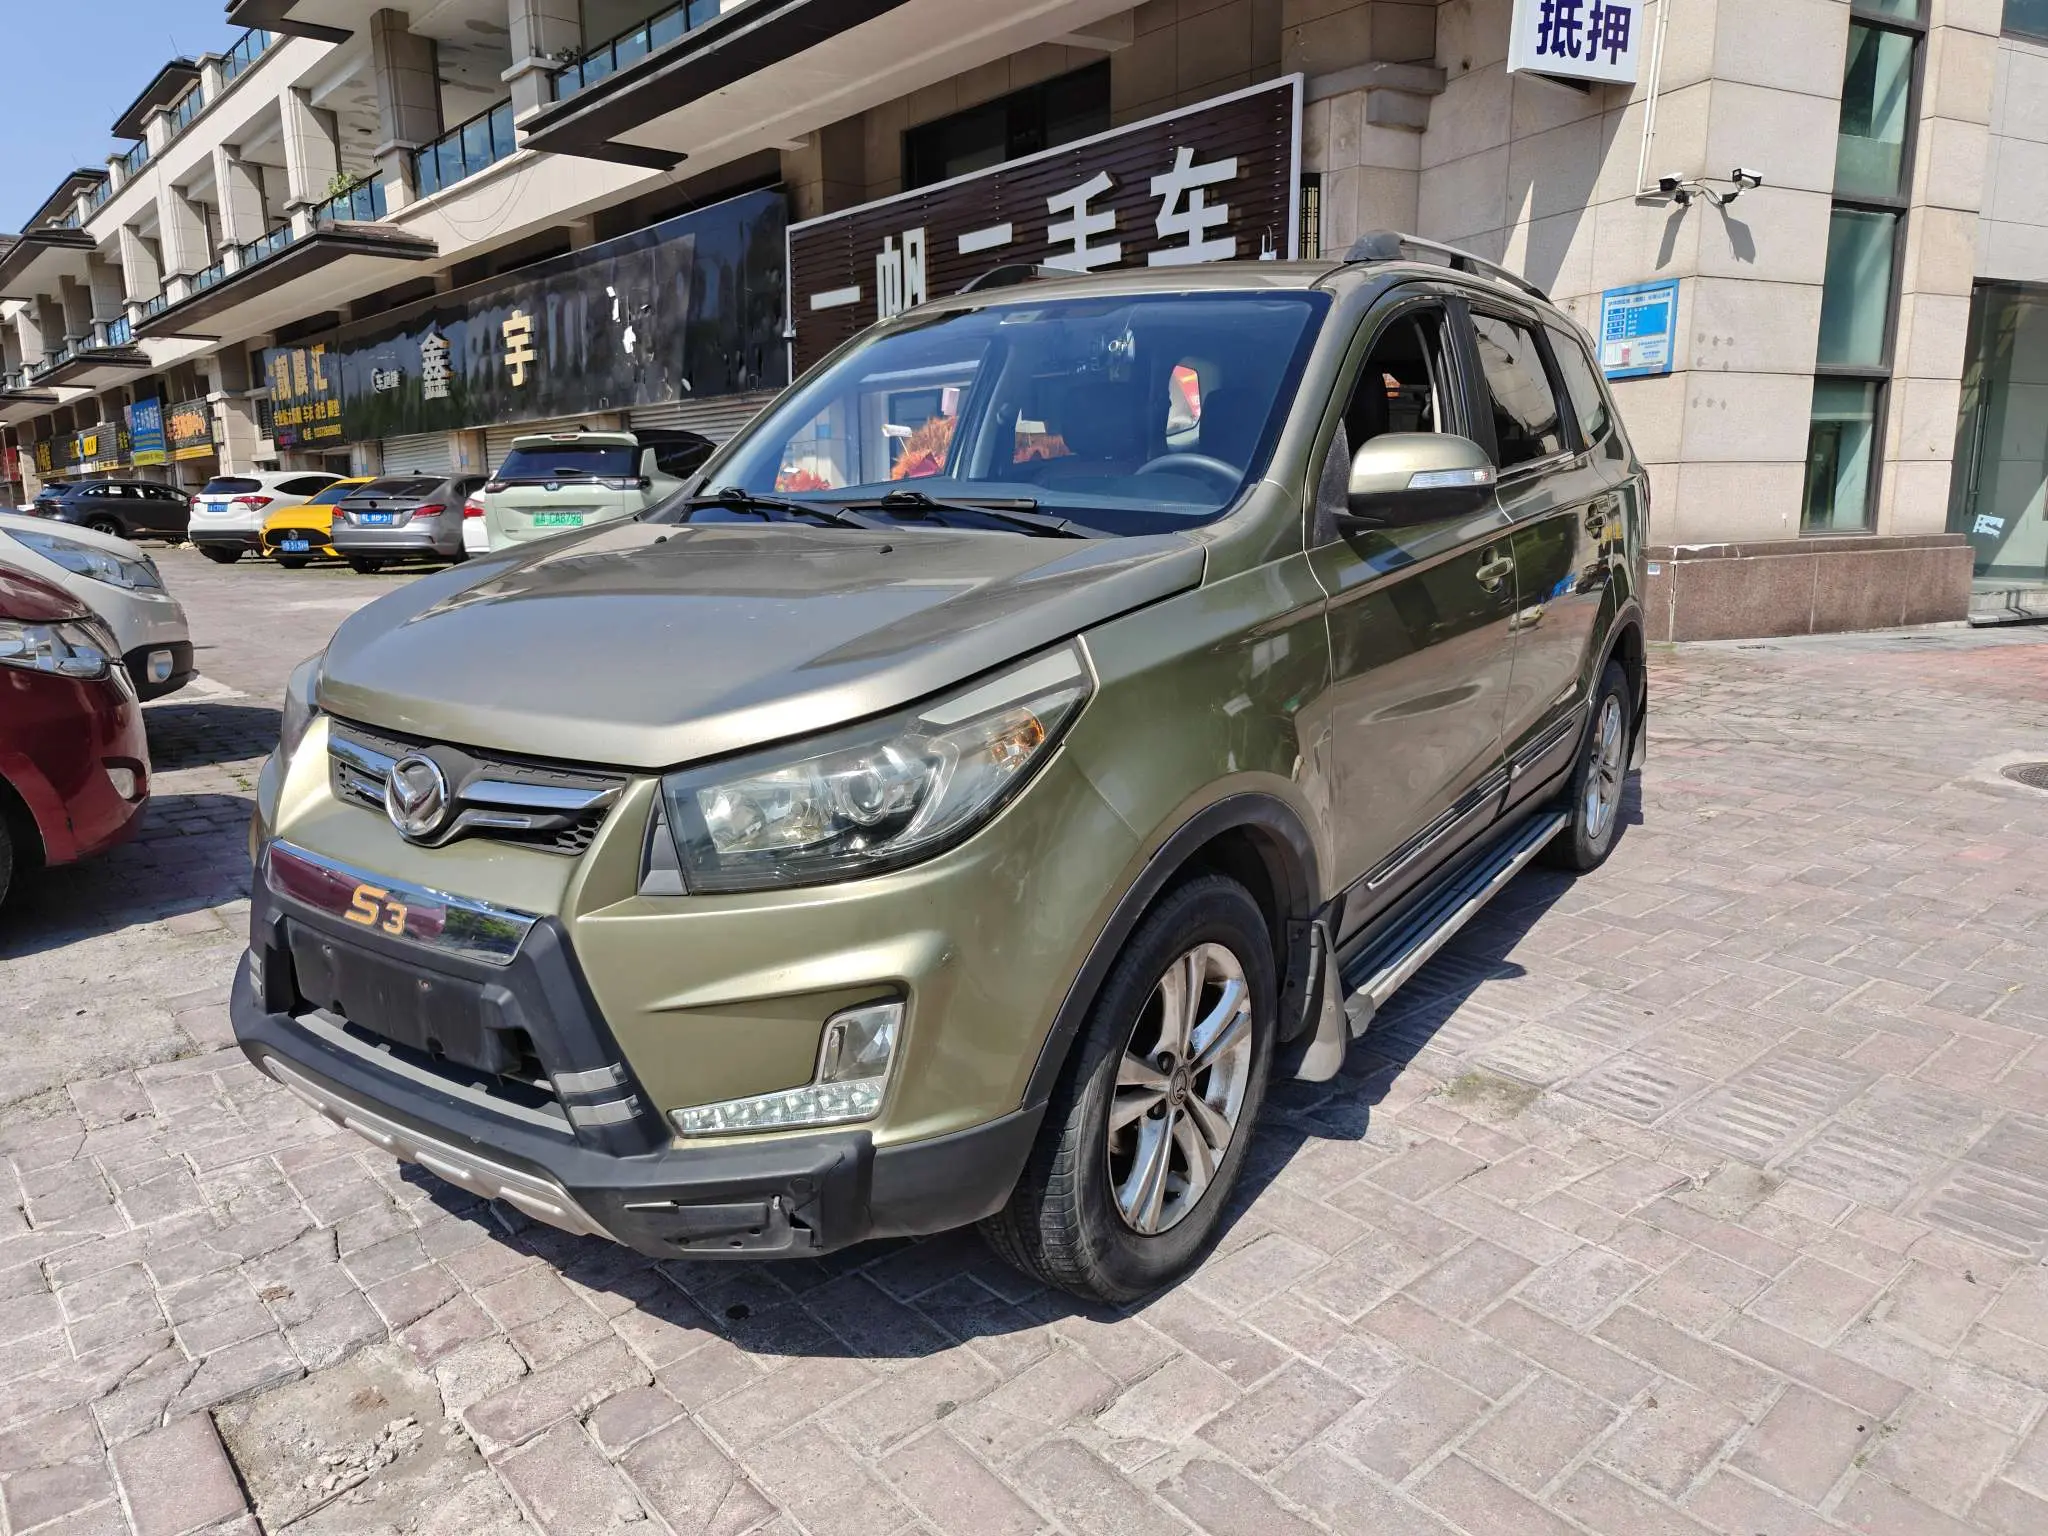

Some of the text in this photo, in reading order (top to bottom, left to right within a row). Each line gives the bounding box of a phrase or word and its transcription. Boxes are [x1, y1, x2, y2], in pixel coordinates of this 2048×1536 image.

[1536, 0, 1632, 65] 抵押
[420, 309, 538, 400] 鑫宇
[344, 884, 408, 936] S3
